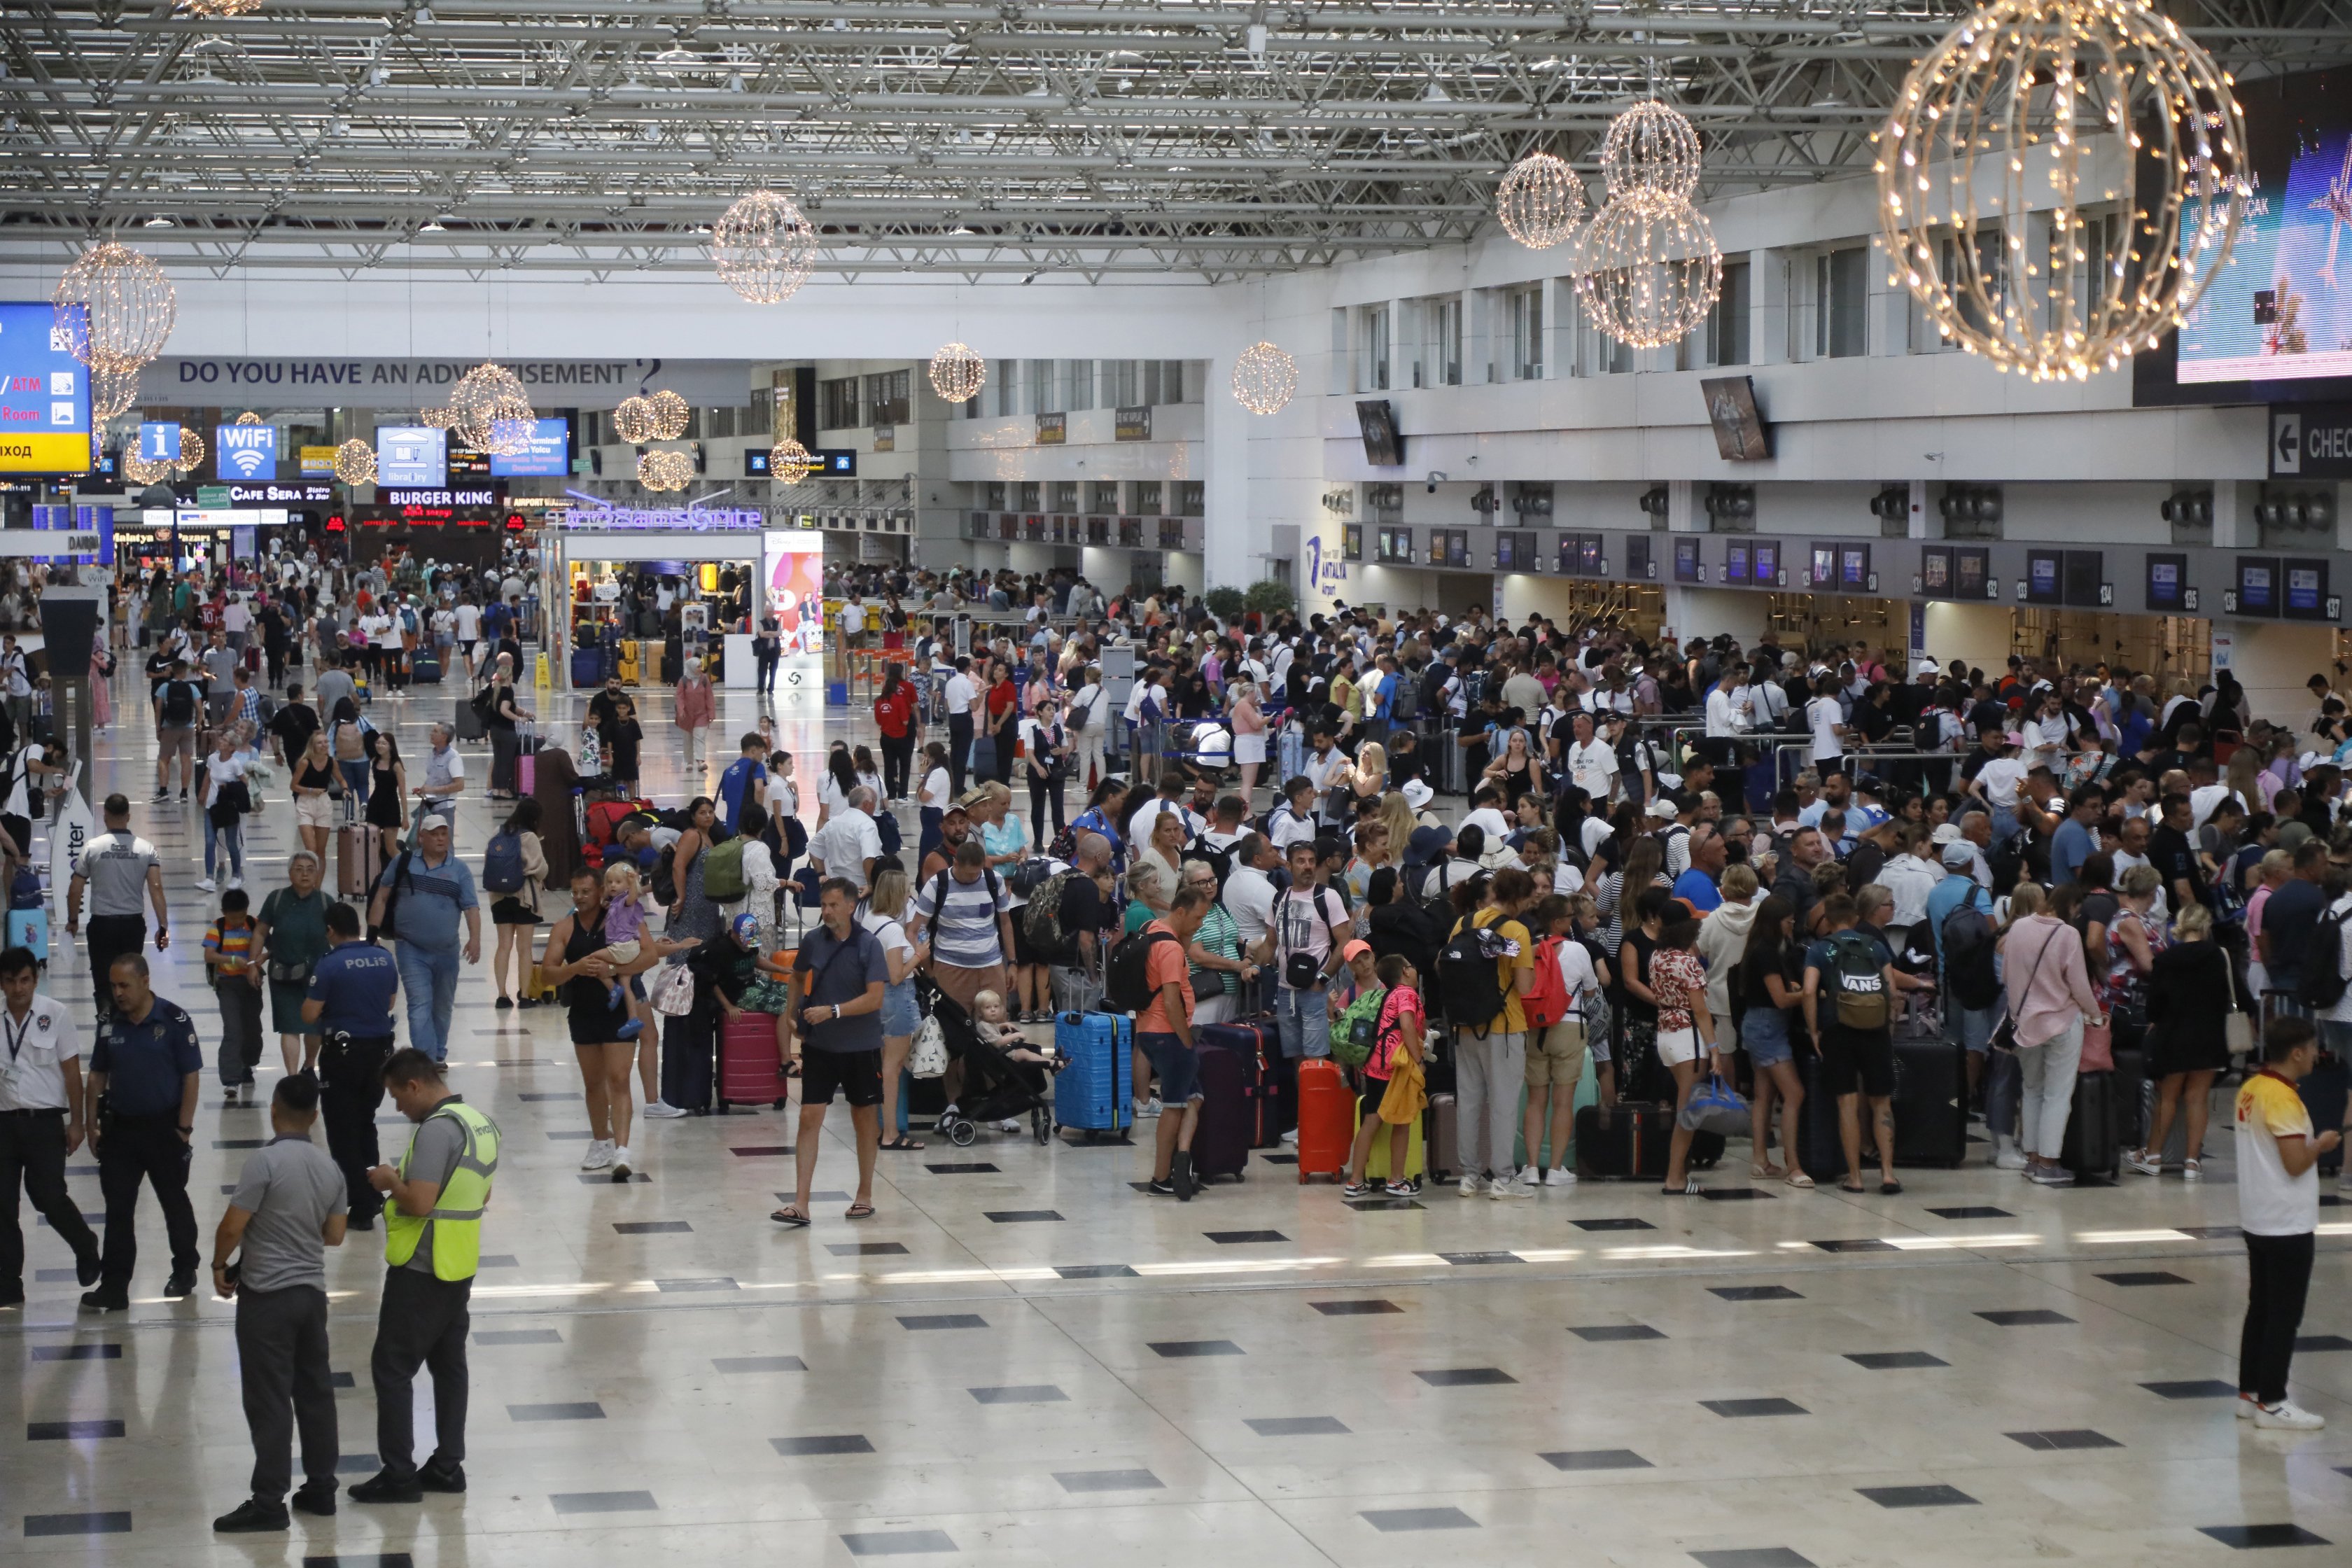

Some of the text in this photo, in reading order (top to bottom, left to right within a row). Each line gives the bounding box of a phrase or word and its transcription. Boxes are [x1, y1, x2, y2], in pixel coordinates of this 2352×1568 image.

[179, 361, 219, 383] DO
[225, 362, 282, 384] YOU
[291, 363, 362, 384] HAVE
[371, 363, 407, 384] AN
[416, 363, 627, 384] ADVTISEMENT
[12, 377, 41, 392] ATM
[3, 407, 39, 421] Room
[225, 428, 272, 448] WiFi
[230, 486, 302, 500] CAFE SERA
[390, 491, 493, 505] BURGER KING
[514, 498, 544, 507] AIRPORT
[568, 508, 603, 519] House
[1322, 562, 1347, 580] ANTALYA
[1987, 579, 1997, 598] 132
[2017, 581, 2027, 599] 133
[2101, 585, 2113, 603] 134
[2185, 590, 2197, 609] 135
[2224, 592, 2237, 611] 136
[2326, 598, 2340, 618] 137
[1840, 969, 1882, 991] VANS
